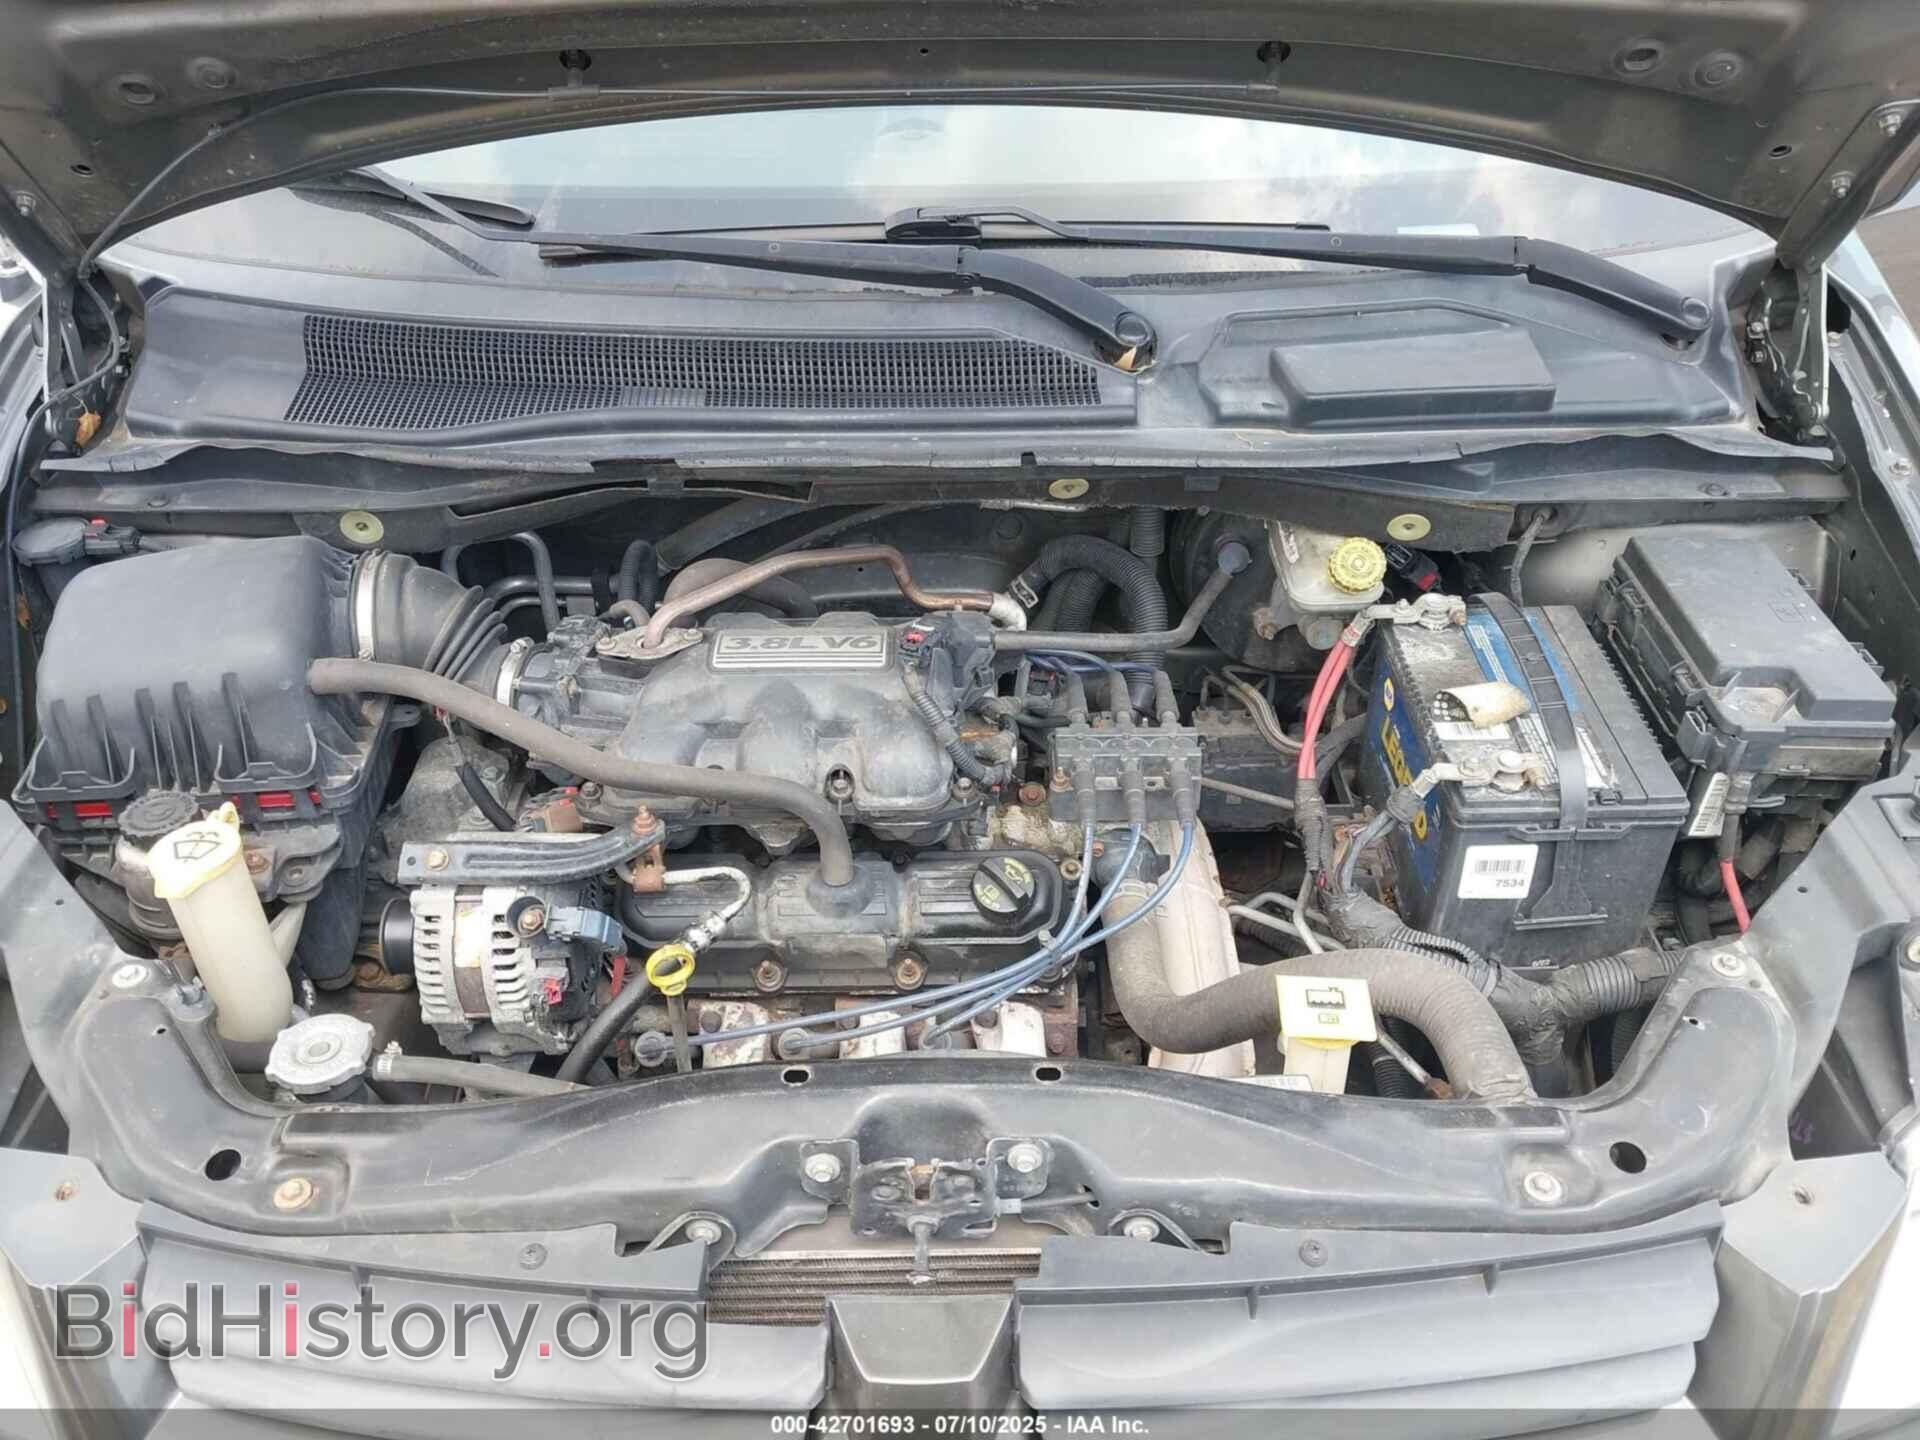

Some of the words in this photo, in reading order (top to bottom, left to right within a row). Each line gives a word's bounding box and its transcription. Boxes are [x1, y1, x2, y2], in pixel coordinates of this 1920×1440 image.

[724, 636, 818, 650] 3.8L
[824, 636, 878, 649] V6
[1494, 879, 1526, 888] 7534
